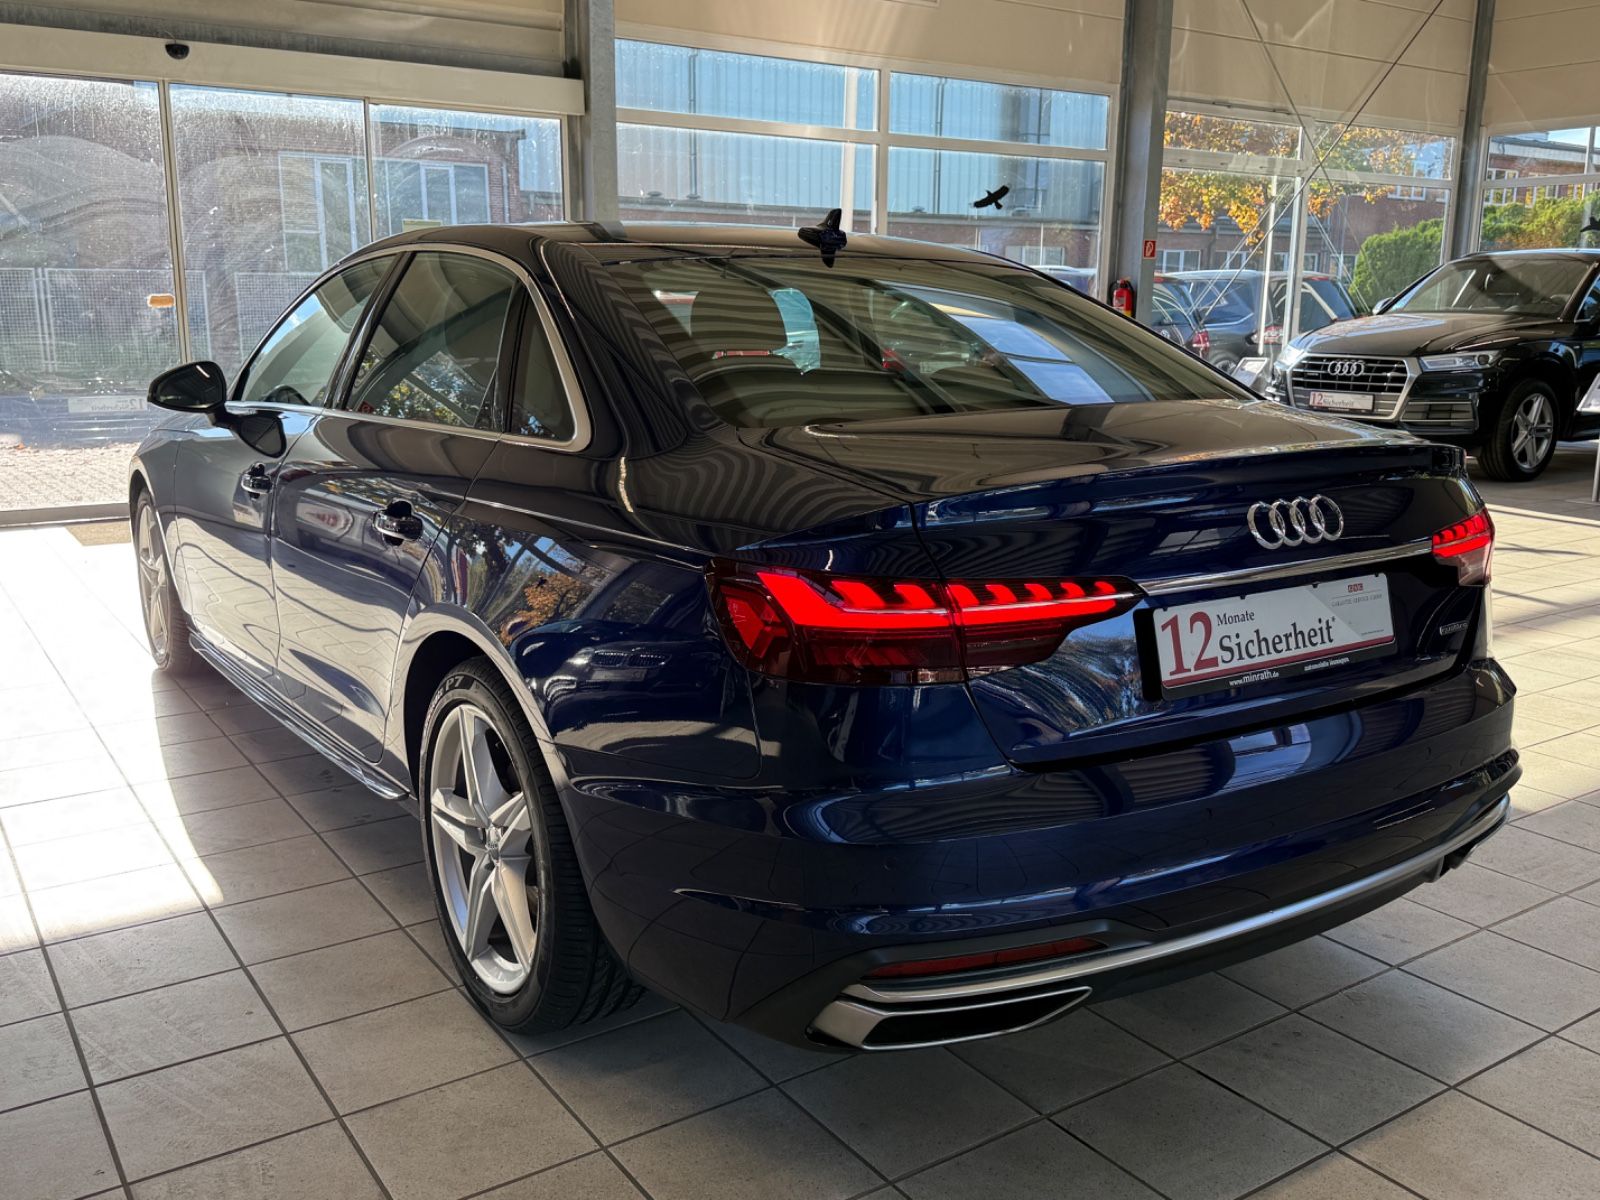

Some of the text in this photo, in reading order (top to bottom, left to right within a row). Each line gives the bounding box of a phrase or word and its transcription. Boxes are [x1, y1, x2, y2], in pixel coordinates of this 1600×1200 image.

[1311, 393, 1324, 406] 12
[1216, 610, 1256, 627] Monate
[1160, 611, 1220, 677] 12
[445, 675, 465, 691] P7
[1228, 669, 1280, 687] www.minrath.de
